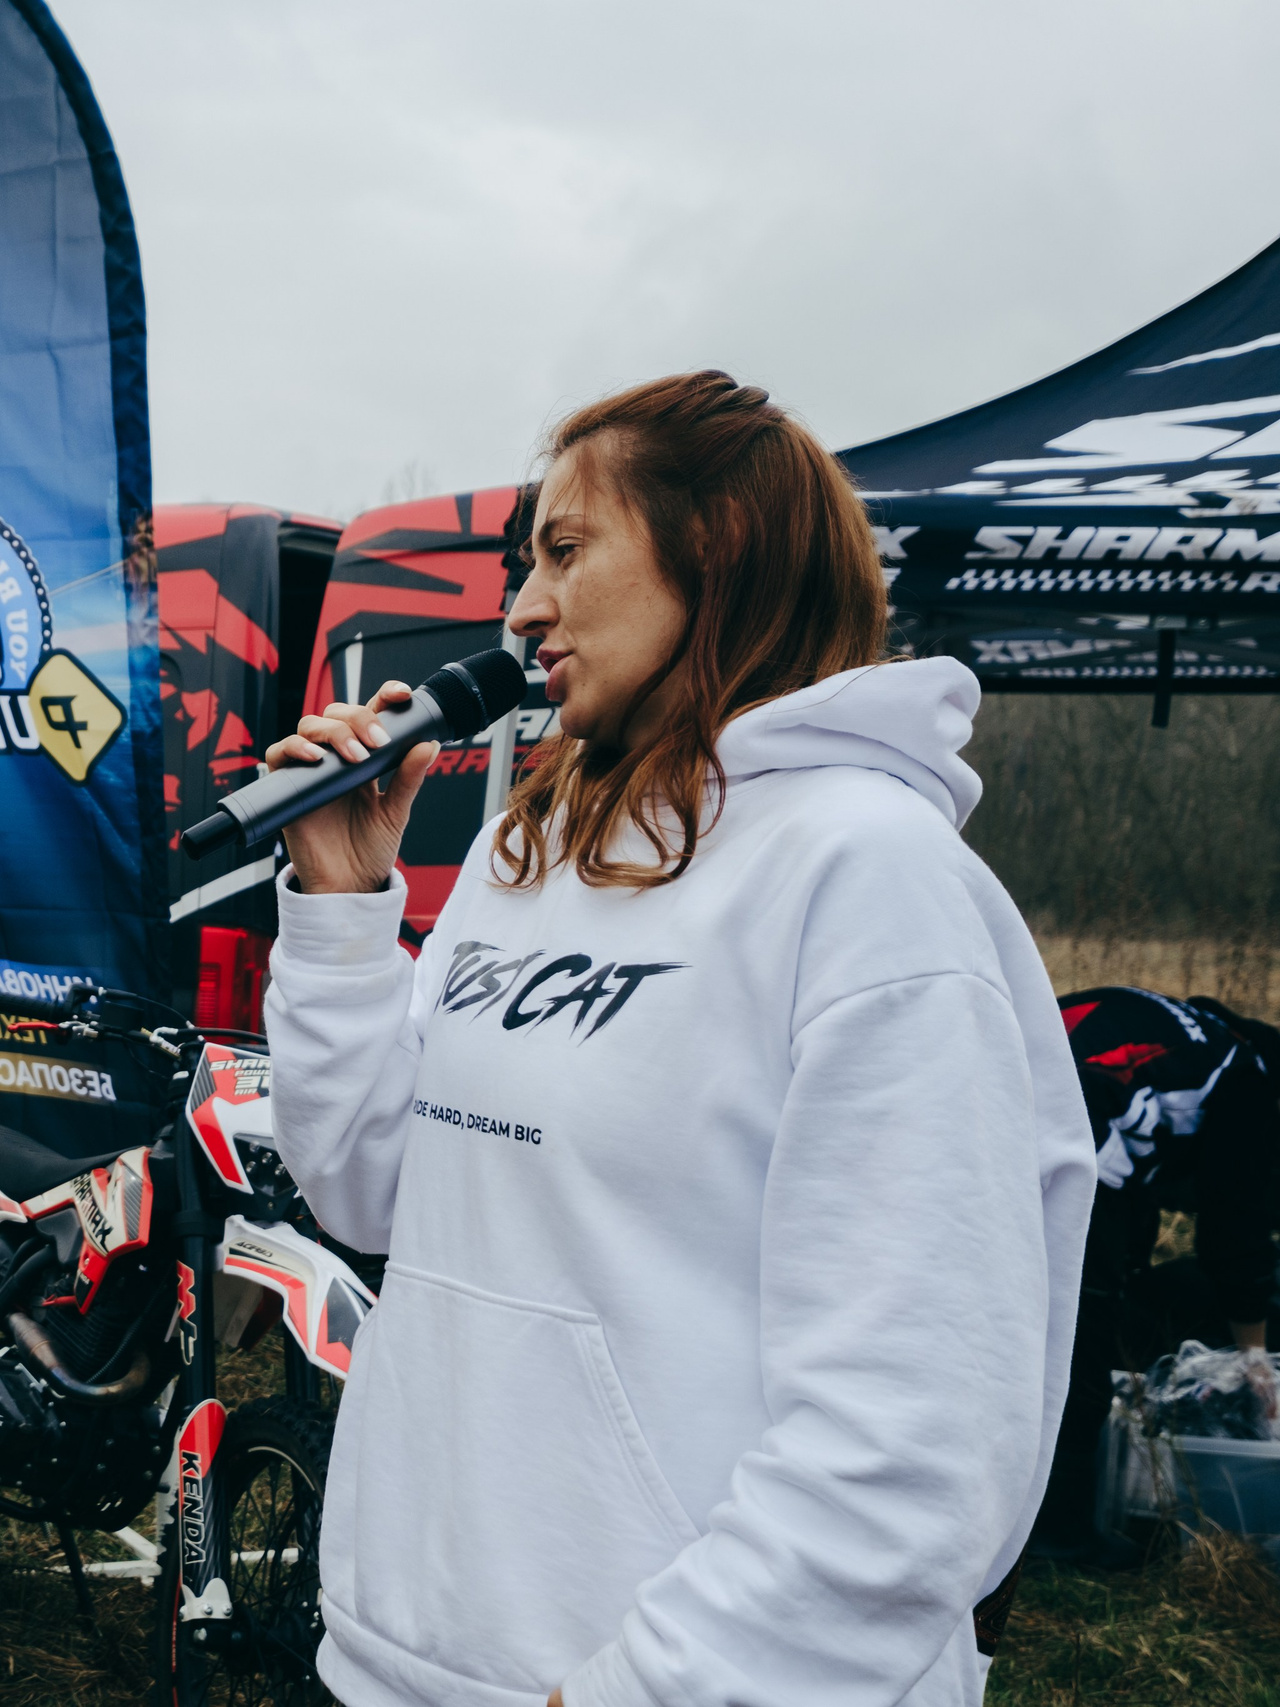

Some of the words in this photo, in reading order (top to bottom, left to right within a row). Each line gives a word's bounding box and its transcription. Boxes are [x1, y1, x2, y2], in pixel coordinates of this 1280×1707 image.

[429, 1104, 465, 1130] HARD,
[466, 1113, 510, 1138] DREAM
[514, 1124, 542, 1145] BIG
[181, 1450, 207, 1565] KENDA
